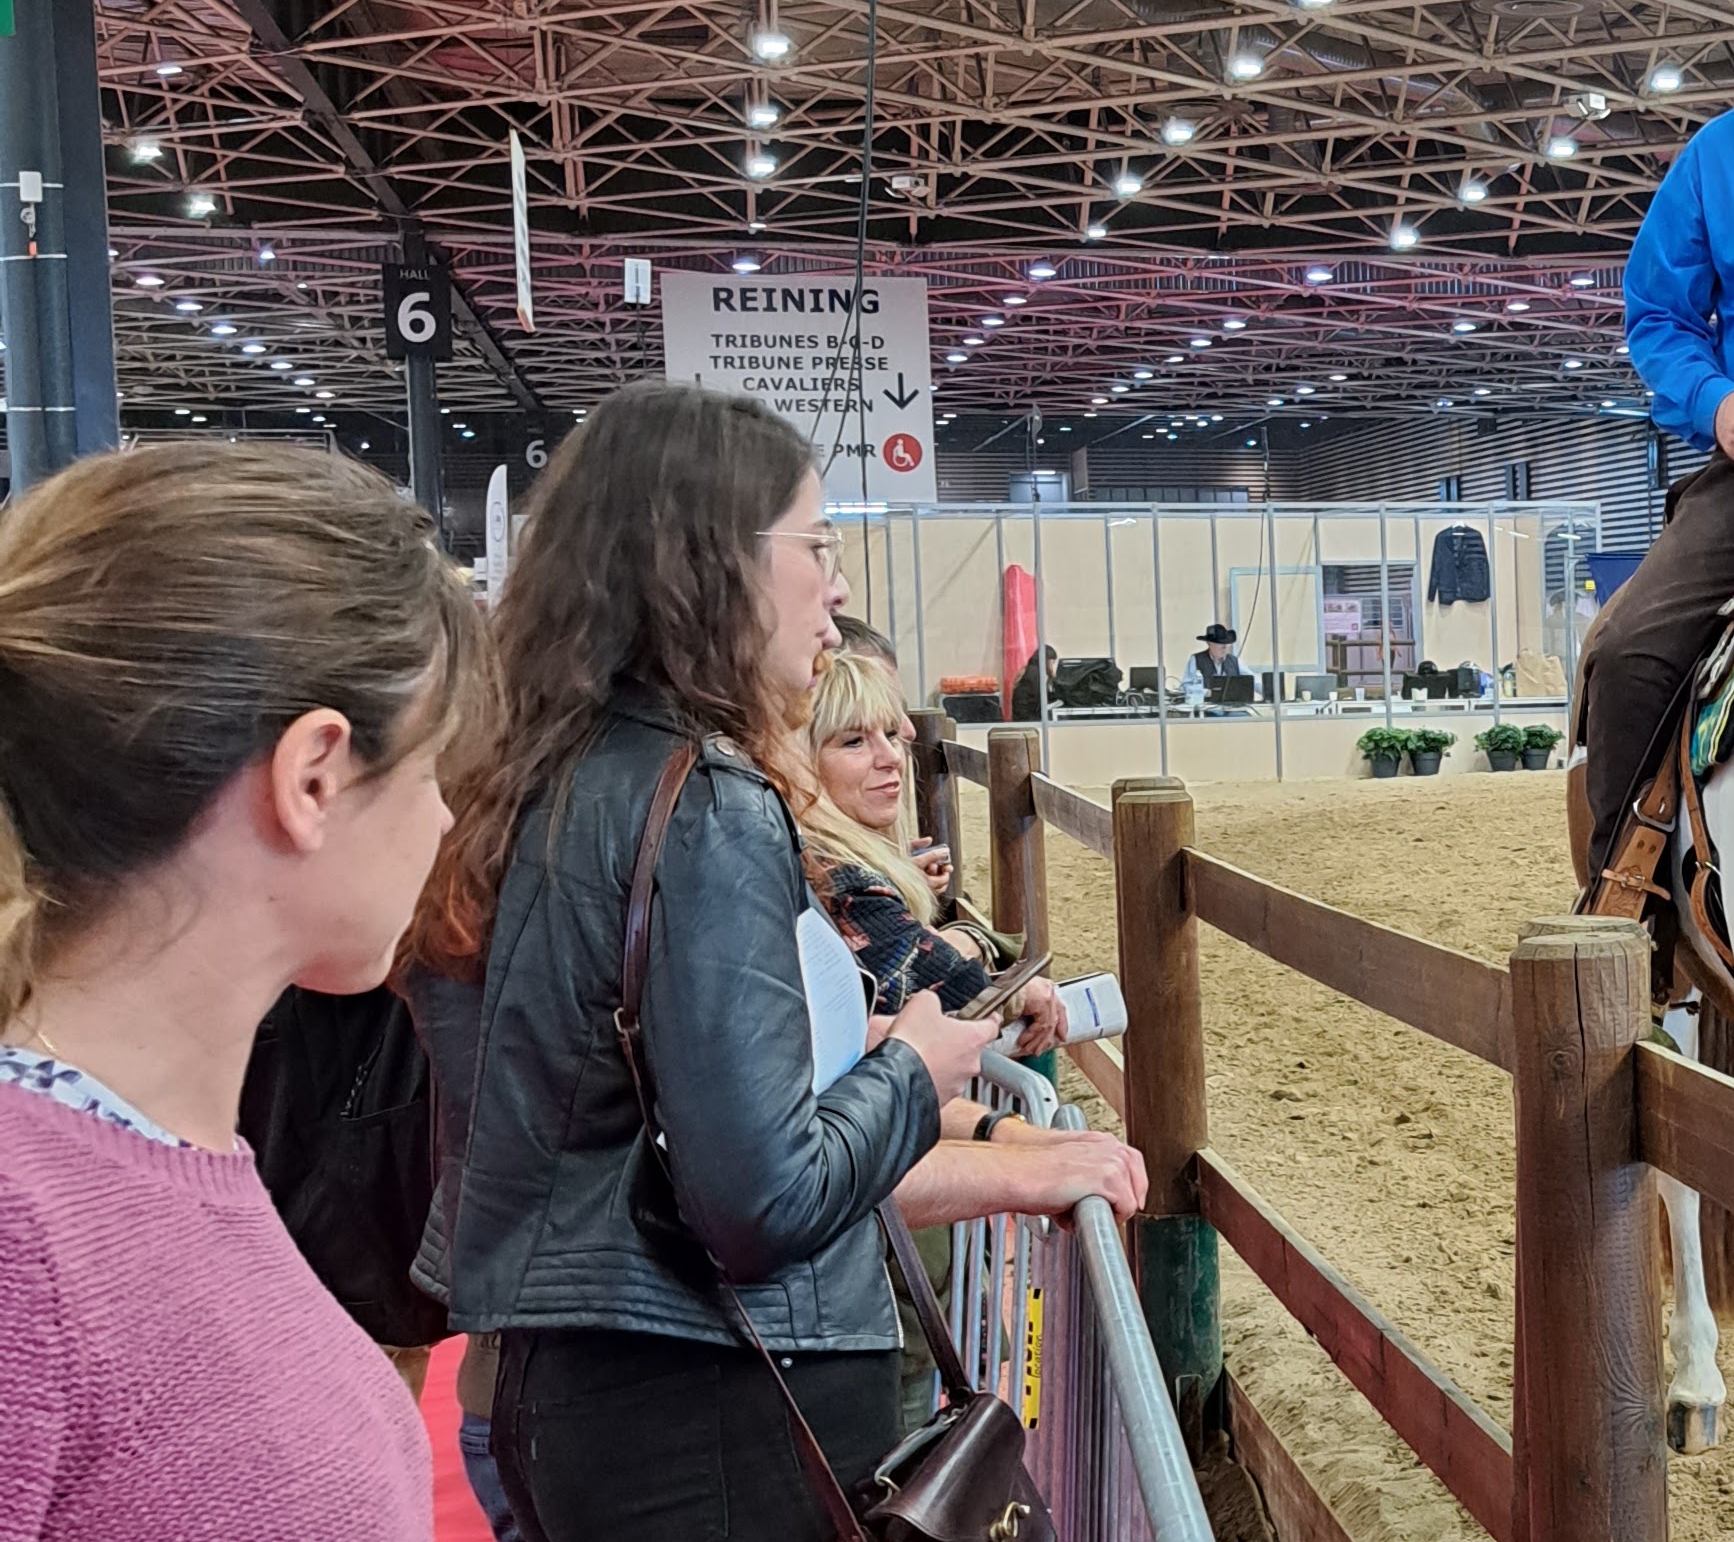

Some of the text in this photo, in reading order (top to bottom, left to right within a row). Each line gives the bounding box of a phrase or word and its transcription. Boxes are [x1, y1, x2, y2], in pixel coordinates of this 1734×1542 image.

[399, 269, 431, 280] HALL
[712, 287, 880, 315] REINING
[397, 291, 437, 343] 6
[710, 334, 819, 349] TRIBUNES
[709, 355, 889, 371] TRIBUNE PRESSE
[742, 377, 860, 391] CAVALIERS
[774, 398, 874, 413] WESTERN
[525, 439, 548, 469] 6
[833, 444, 877, 458] PMR
